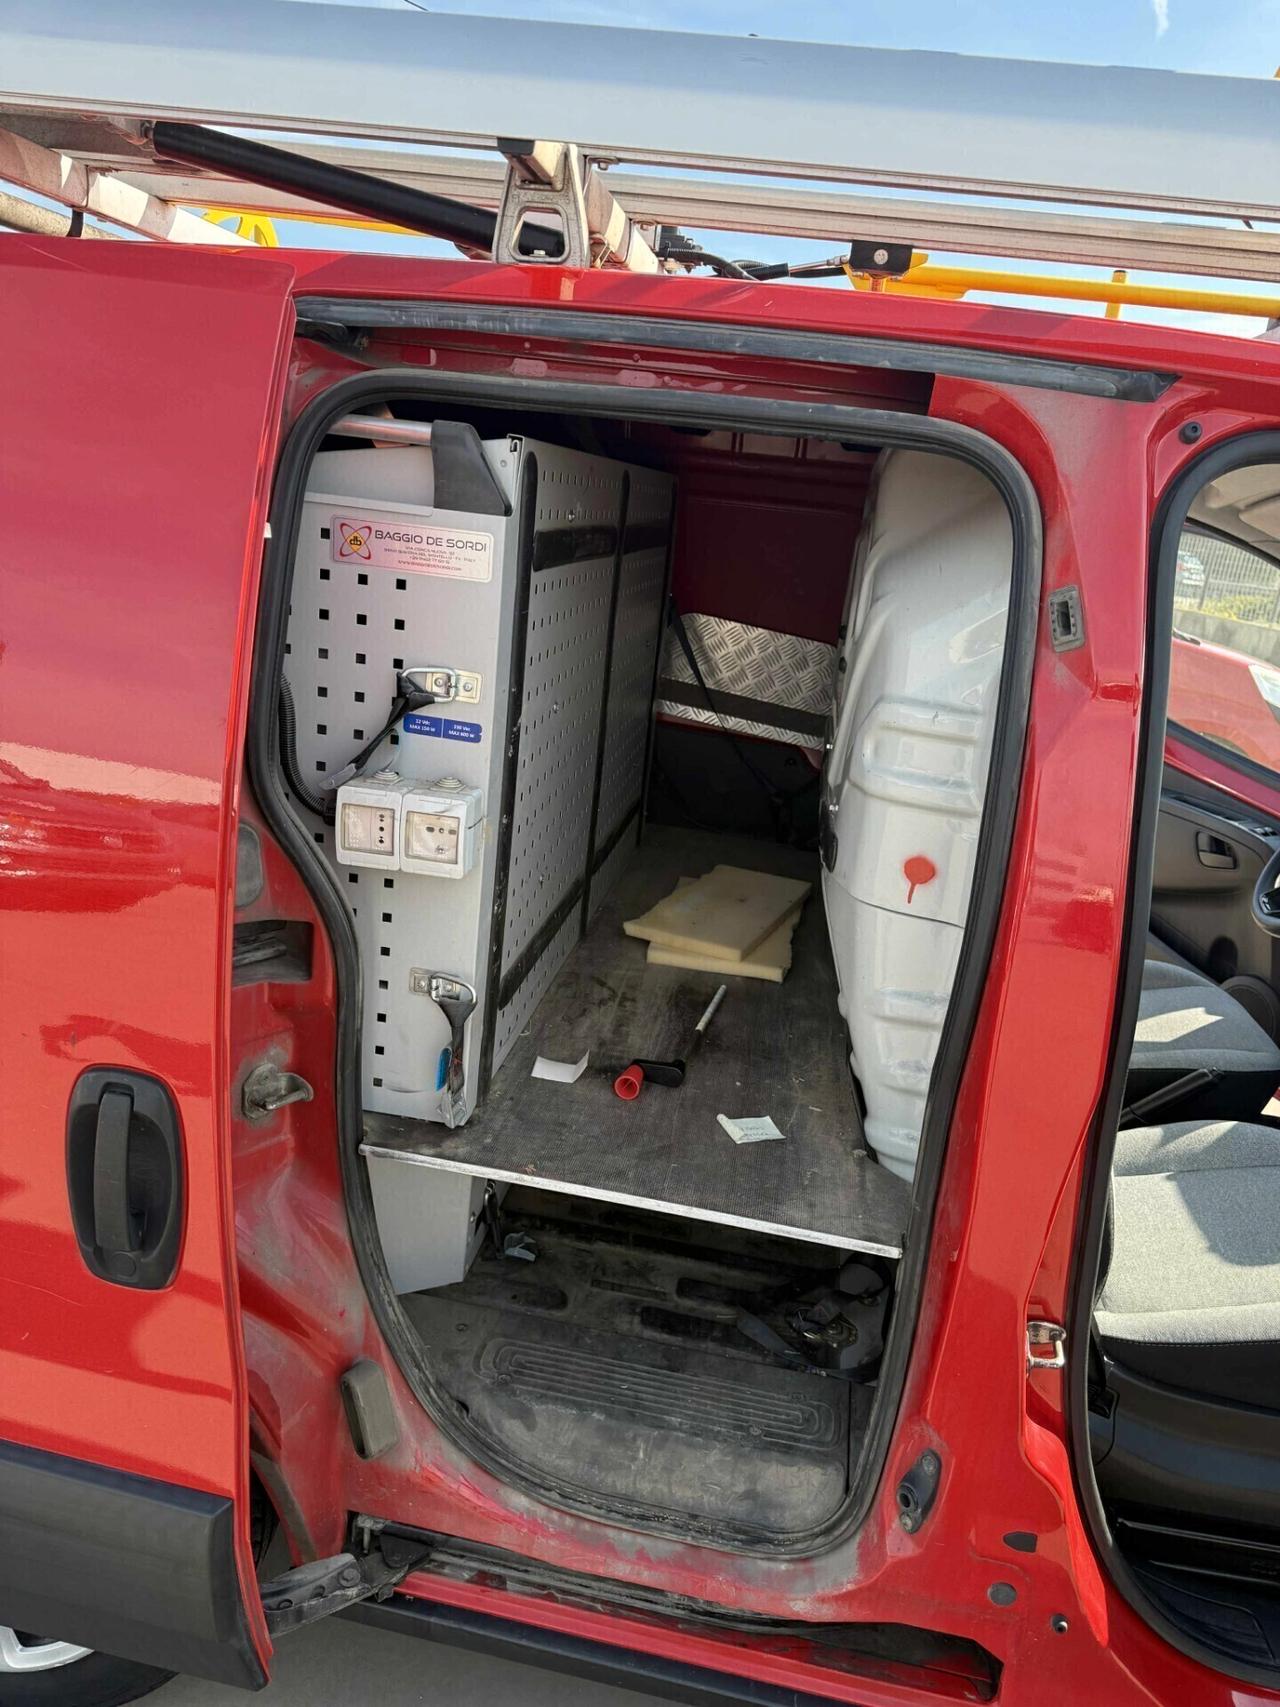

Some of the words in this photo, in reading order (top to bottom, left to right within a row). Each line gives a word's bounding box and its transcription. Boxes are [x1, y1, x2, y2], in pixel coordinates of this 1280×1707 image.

[374, 529, 423, 544] BAGGIO
[426, 535, 444, 547] DE
[446, 538, 487, 552] SORDI
